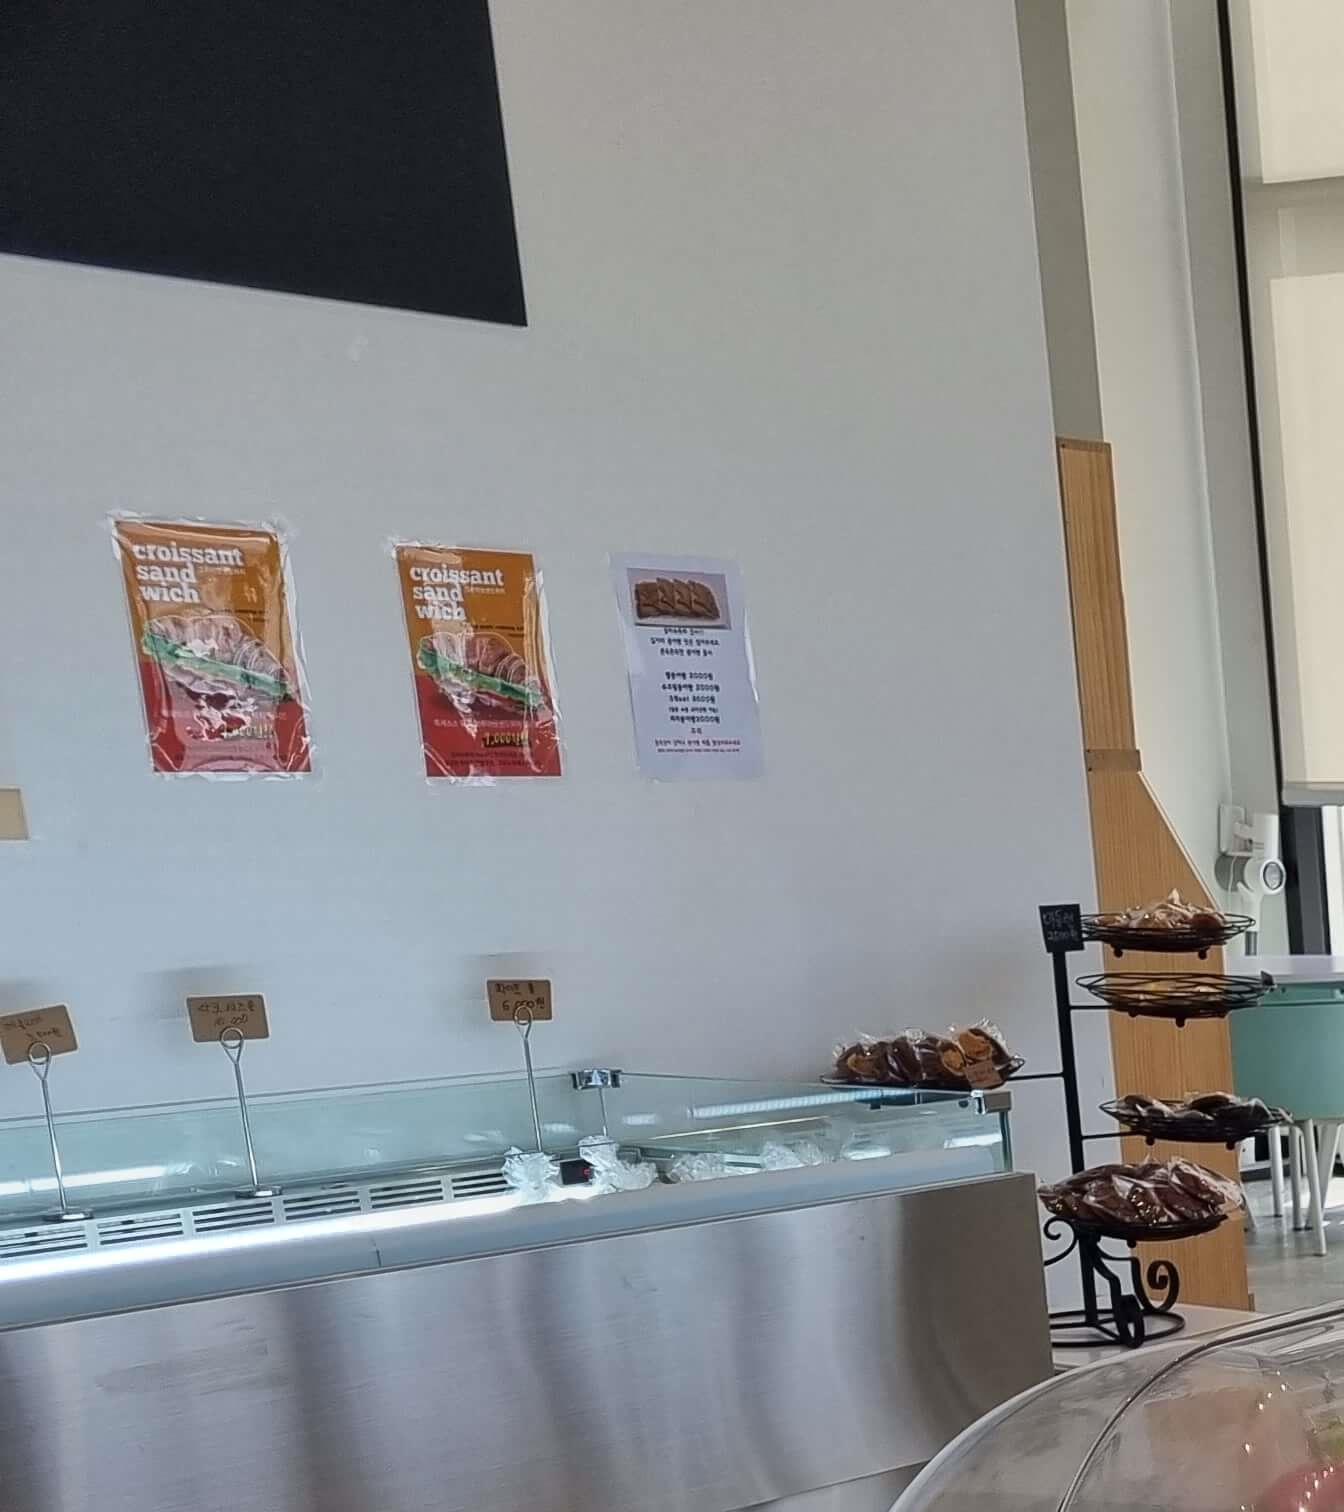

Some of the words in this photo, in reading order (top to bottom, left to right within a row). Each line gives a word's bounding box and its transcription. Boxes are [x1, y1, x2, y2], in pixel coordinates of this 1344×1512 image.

[132, 541, 245, 567] croissant
[136, 563, 197, 583] sand
[409, 563, 505, 586] croissant
[140, 581, 201, 604] wich
[412, 582, 464, 602] sand
[415, 599, 466, 621] wich
